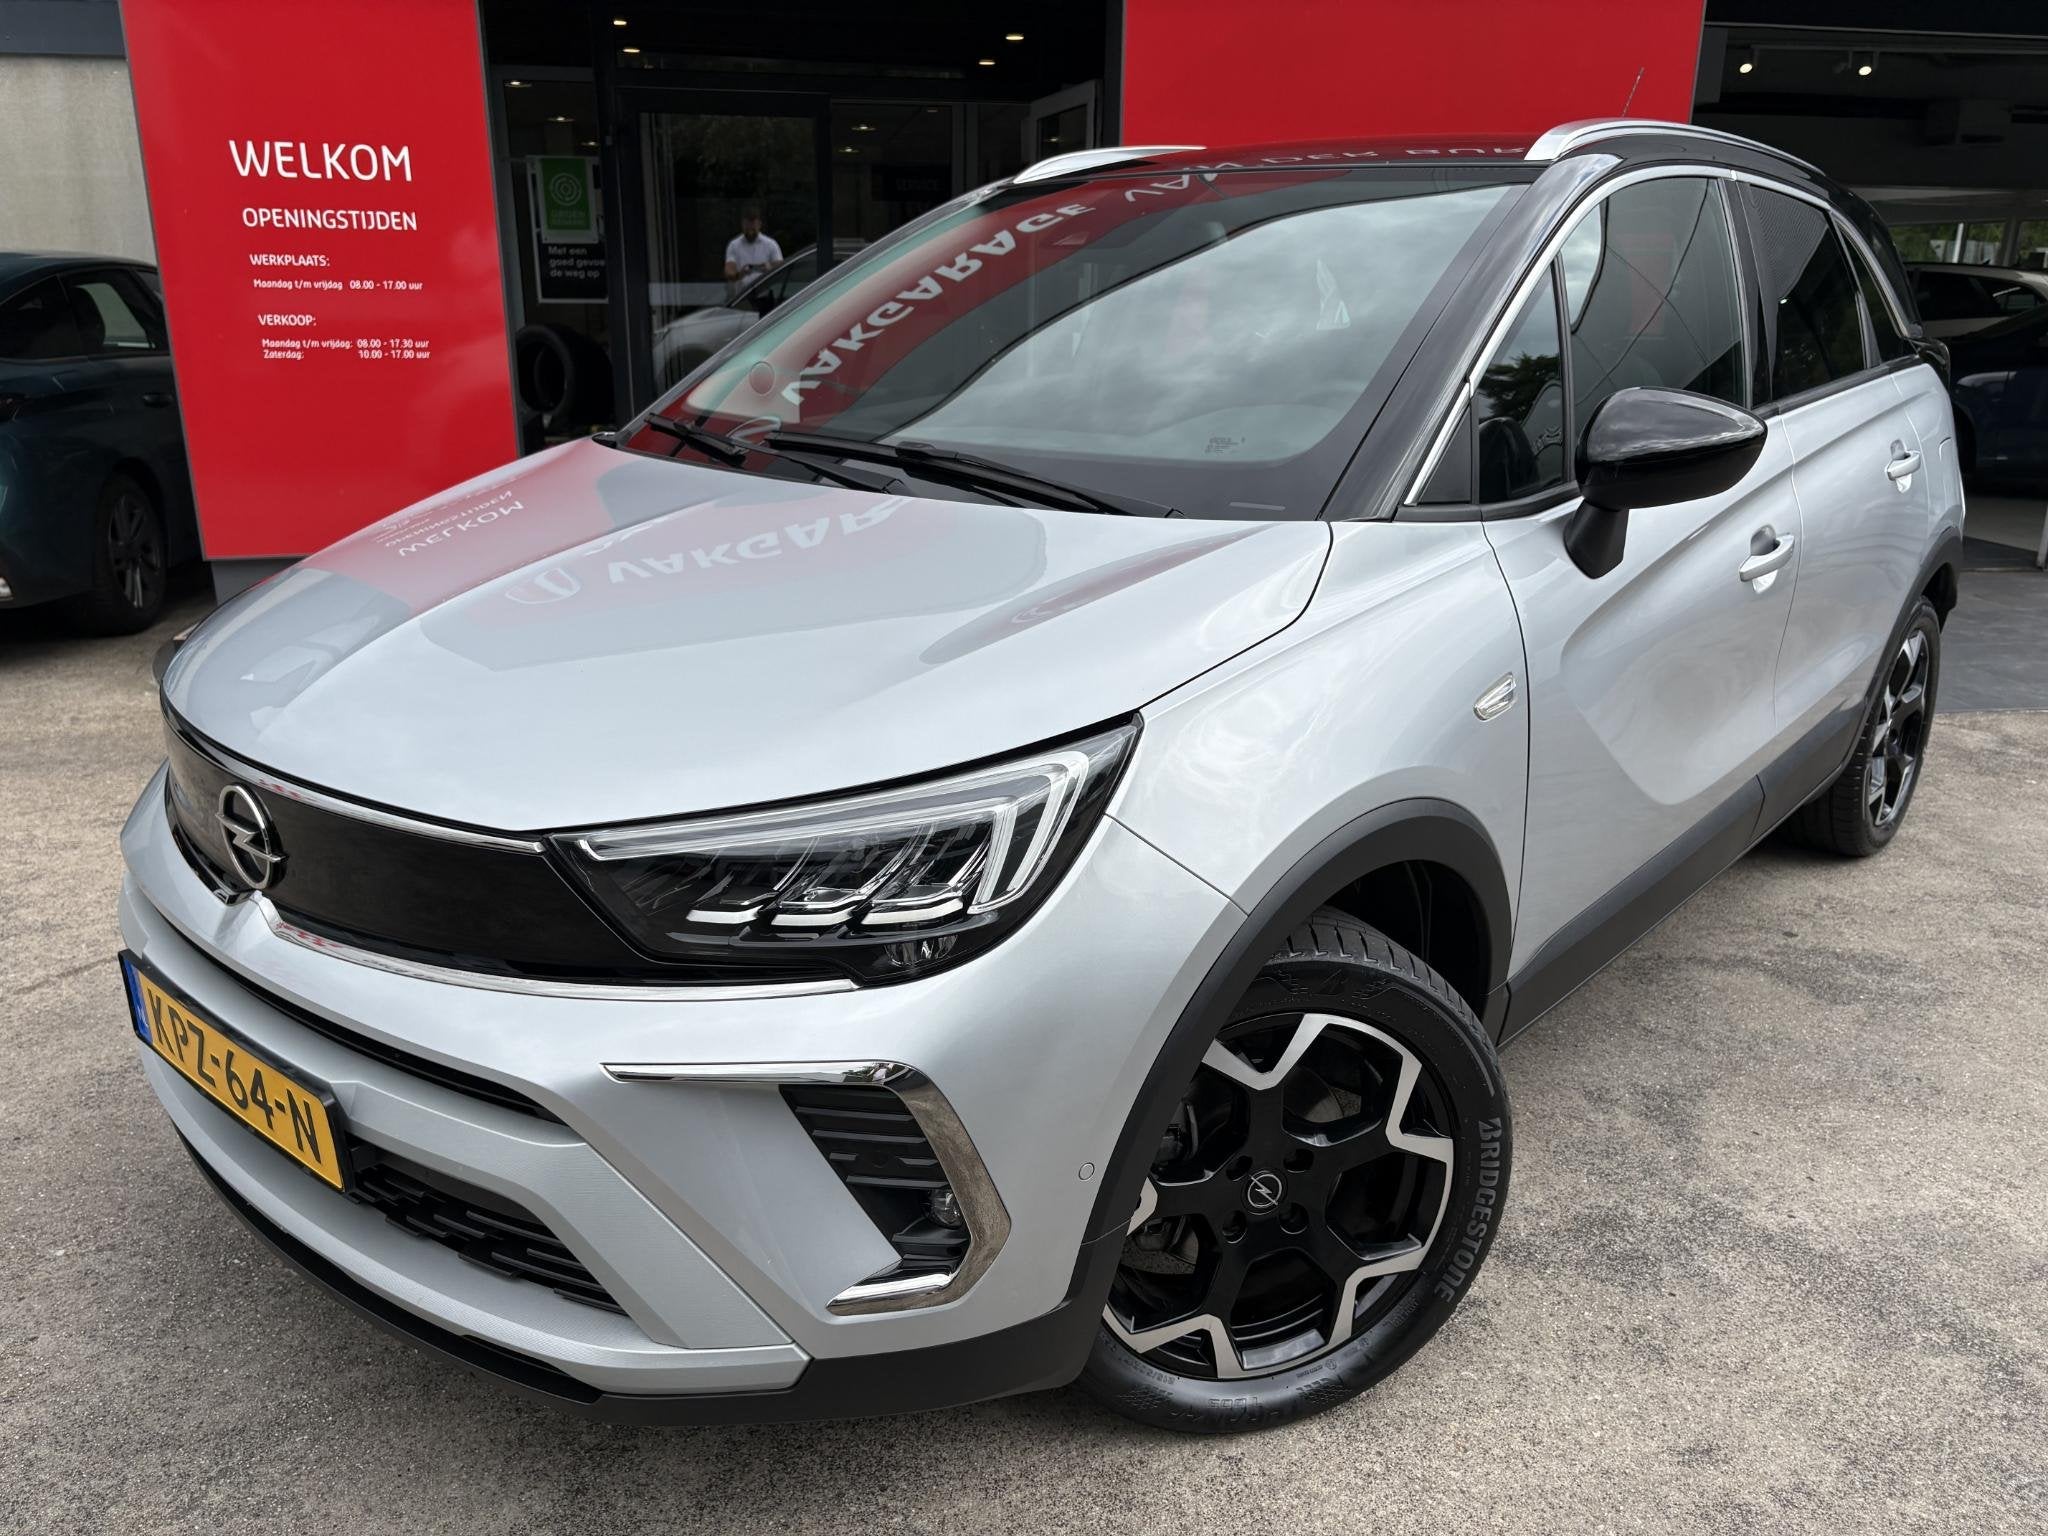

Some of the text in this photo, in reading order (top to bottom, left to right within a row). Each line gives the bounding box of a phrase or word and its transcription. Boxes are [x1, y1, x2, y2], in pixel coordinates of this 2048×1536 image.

[228, 139, 413, 182] WELKOM
[242, 206, 417, 231] OPENINGSTIJDEN
[249, 254, 331, 267] WERKPLAATS:
[550, 259, 574, 268] goed
[587, 270, 600, 278] op
[253, 278, 293, 290] Maandag
[295, 280, 312, 290] t/m
[314, 280, 343, 291] vrijdag
[349, 279, 375, 290] 08.00
[383, 280, 407, 290] 17.00
[408, 282, 424, 290] uur
[258, 314, 317, 327] VERKOOP:
[262, 338, 301, 350] Maandag
[302, 339, 320, 349] t/m
[321, 339, 353, 350] vrijdag:
[357, 338, 382, 349] 08.00
[390, 338, 414, 349] 17.30
[415, 340, 430, 349] uur
[263, 349, 305, 361] Zaterdag:
[359, 349, 383, 360] 10.00
[391, 349, 415, 360] 17.00
[416, 351, 431, 359] uur
[147, 986, 322, 1165] KPZ-64-N
[1433, 1116, 1503, 1303] BRIDGESTONE
